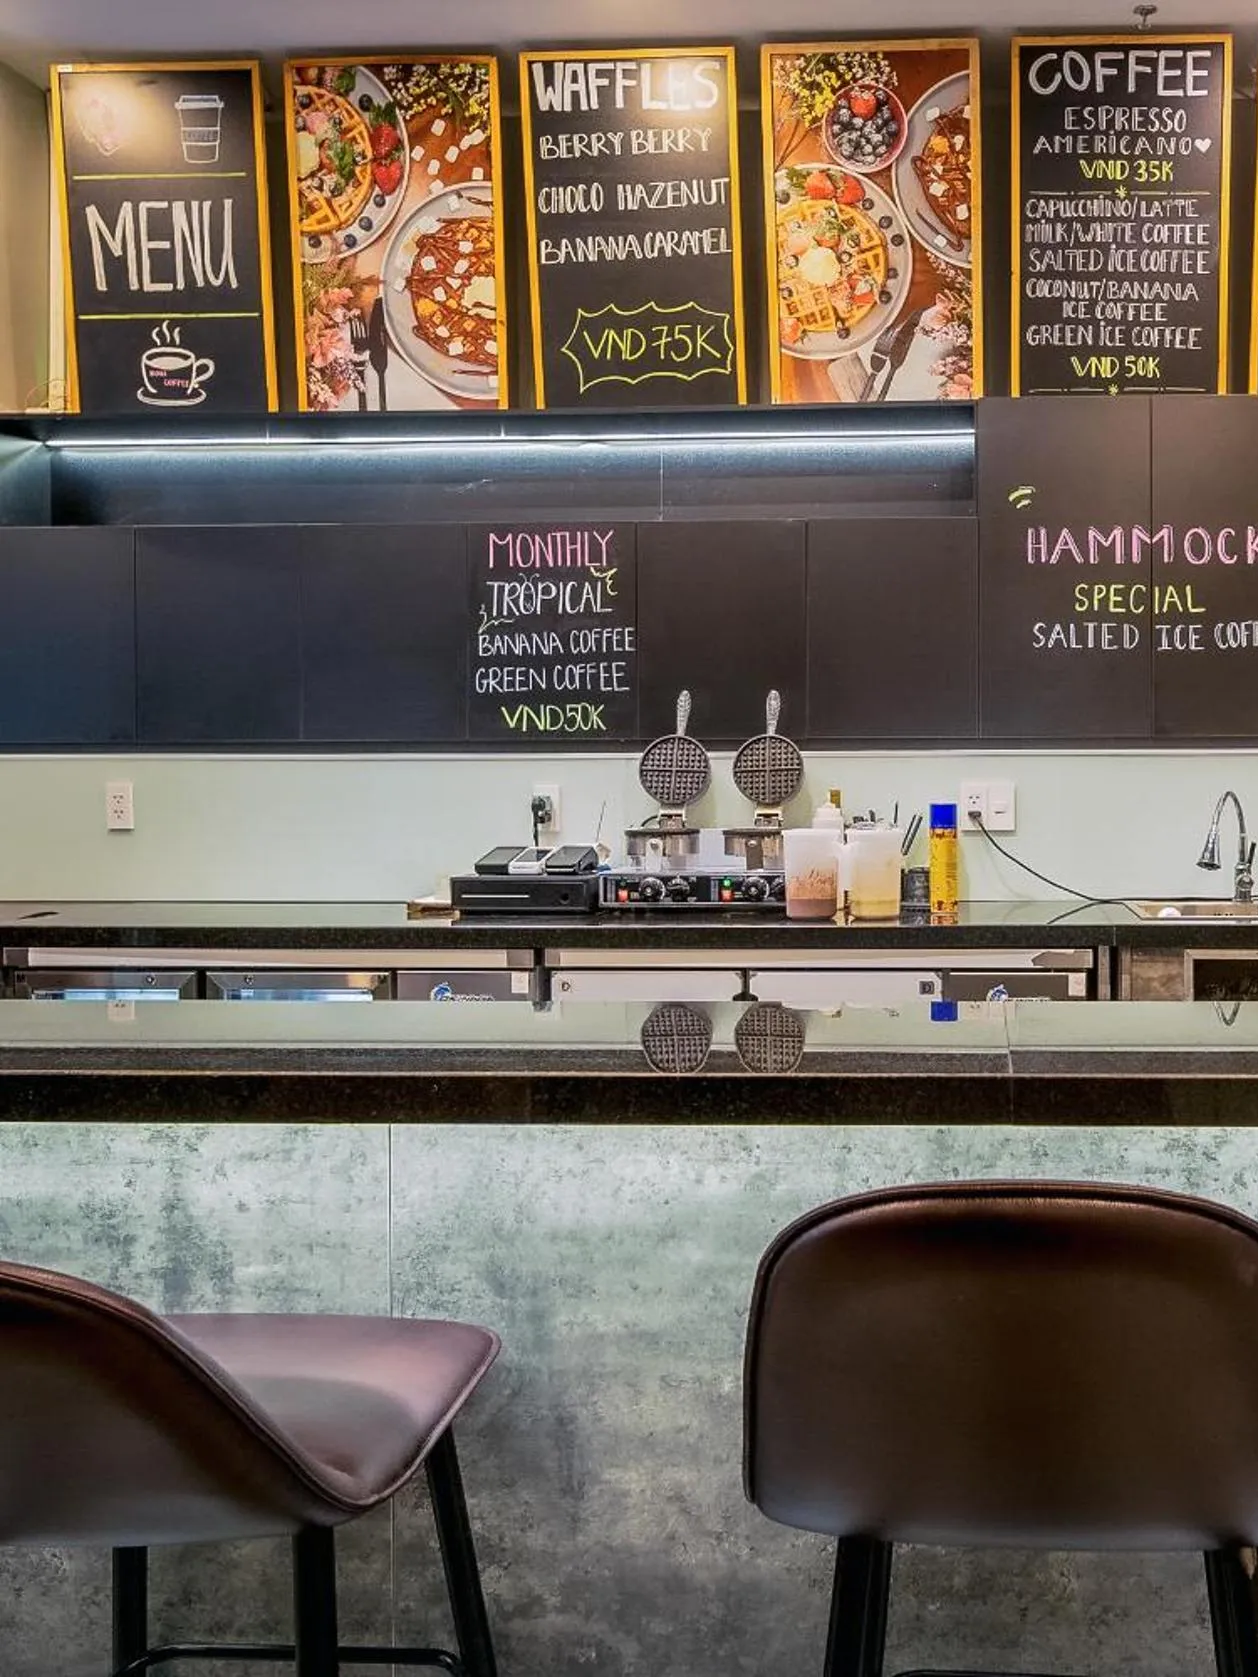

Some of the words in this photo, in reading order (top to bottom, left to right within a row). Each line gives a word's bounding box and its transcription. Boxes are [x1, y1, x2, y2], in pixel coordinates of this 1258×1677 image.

[532, 61, 720, 111] WAFFLES
[1028, 50, 1212, 97] COFFEE
[1064, 105, 1187, 133] ESPRESSO
[539, 132, 624, 160] BERRY
[630, 127, 712, 155] BERRY
[1033, 130, 1192, 156] AMERICANO
[1079, 159, 1129, 180] VND
[1133, 159, 1174, 183] 35K
[538, 182, 604, 214] CHOCO
[616, 177, 730, 211] HAZENUT
[85, 199, 238, 291] MENU
[539, 233, 643, 265] BANANA
[643, 228, 733, 259] CARAMEL
[1141, 222, 1210, 245] COFFEE
[1028, 247, 1104, 273] SALTED
[1107, 244, 1139, 273] ICE
[1140, 249, 1211, 274] COFFEE
[1062, 300, 1091, 319] ICE
[1094, 301, 1168, 322] COFFEE
[583, 327, 647, 361] VND
[651, 324, 722, 362] 75K
[1025, 323, 1093, 346] GREEN
[1099, 321, 1127, 346] ICE
[1131, 326, 1203, 350] COFFEE
[1070, 356, 1120, 378] VND
[1124, 355, 1161, 378] 50K
[488, 529, 614, 568] MONTHLY
[486, 578, 613, 618] TROPICAL
[1074, 583, 1207, 614] SPECIAL
[478, 630, 565, 657] BANANA
[569, 626, 636, 654] COFFEE
[1032, 621, 1140, 650] SALTED
[1155, 624, 1205, 650] ICE
[475, 666, 547, 694] GREEN
[553, 662, 631, 692] COFFEE
